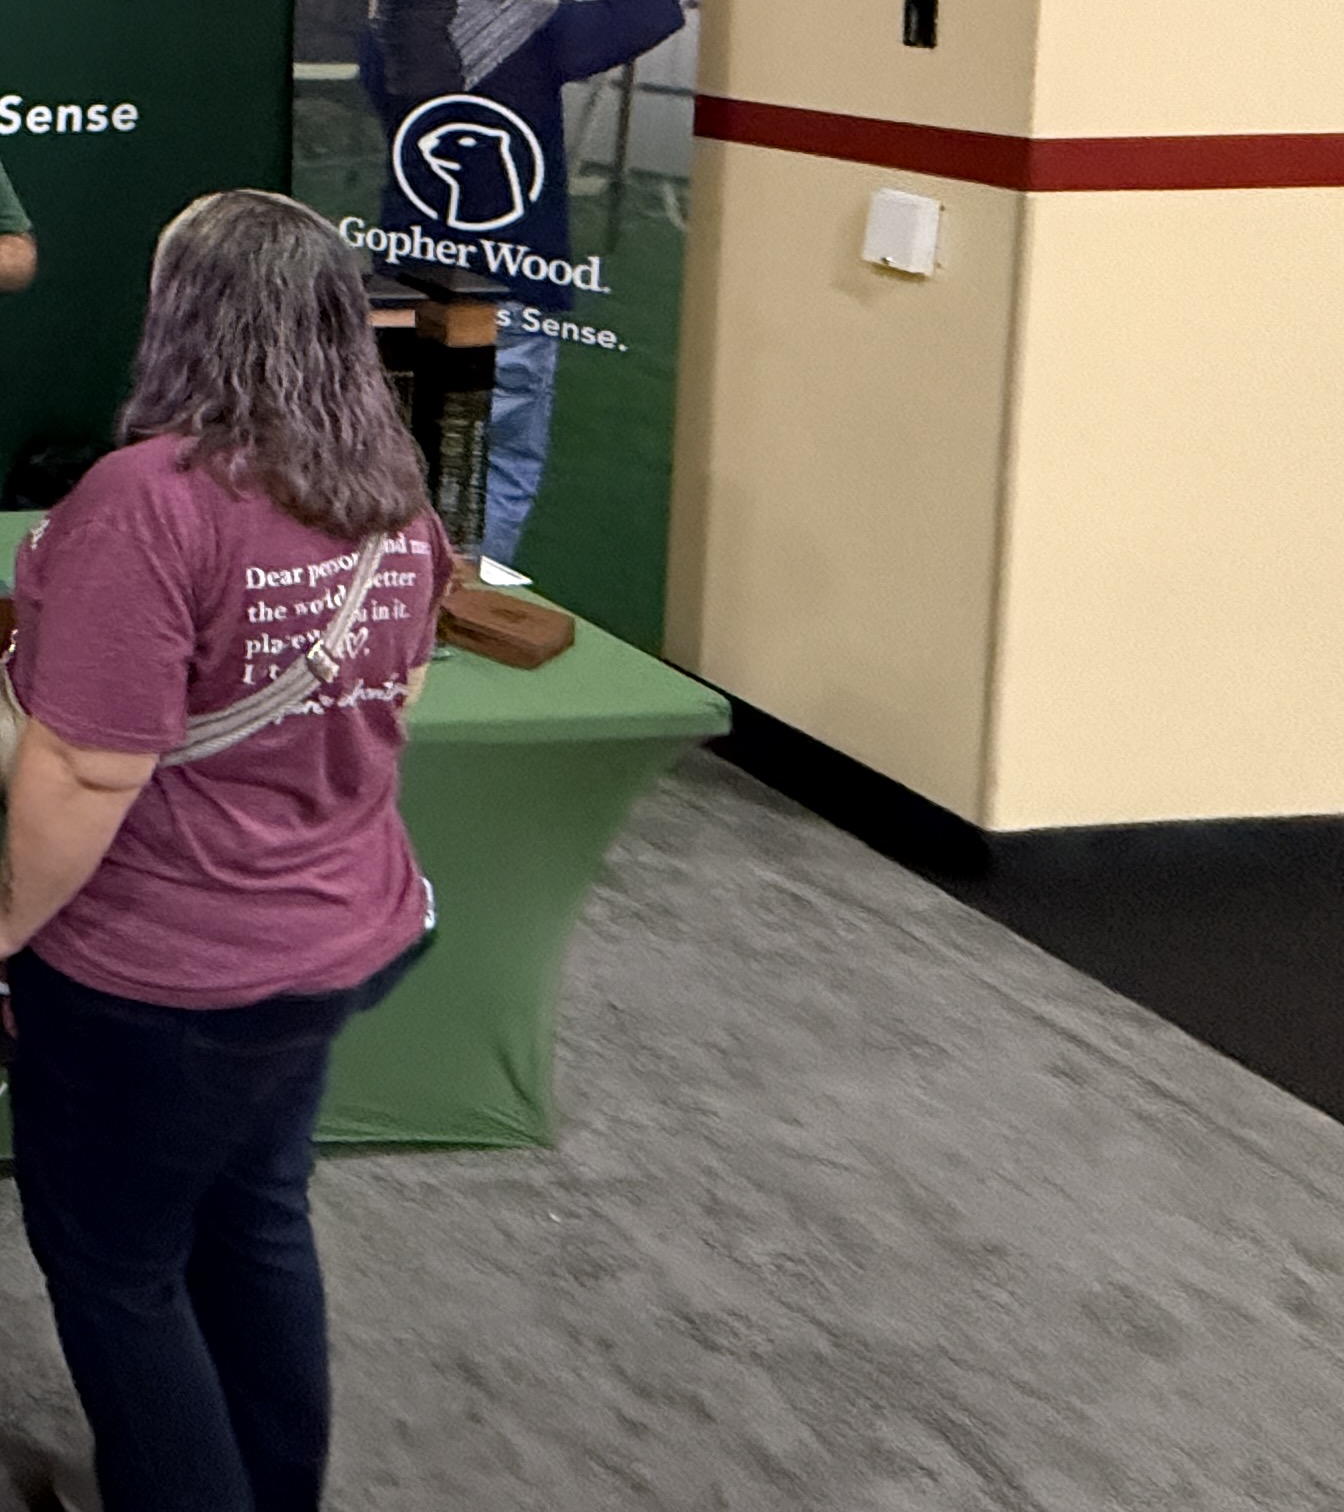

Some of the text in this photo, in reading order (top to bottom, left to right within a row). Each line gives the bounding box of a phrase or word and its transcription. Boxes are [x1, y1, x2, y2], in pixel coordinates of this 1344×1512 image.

[338, 216, 478, 268] Gopher
[521, 306, 629, 352] Sense.
[245, 567, 304, 589] Dear
[247, 601, 288, 623] the
[366, 570, 417, 588] etter
[371, 600, 390, 621] in
